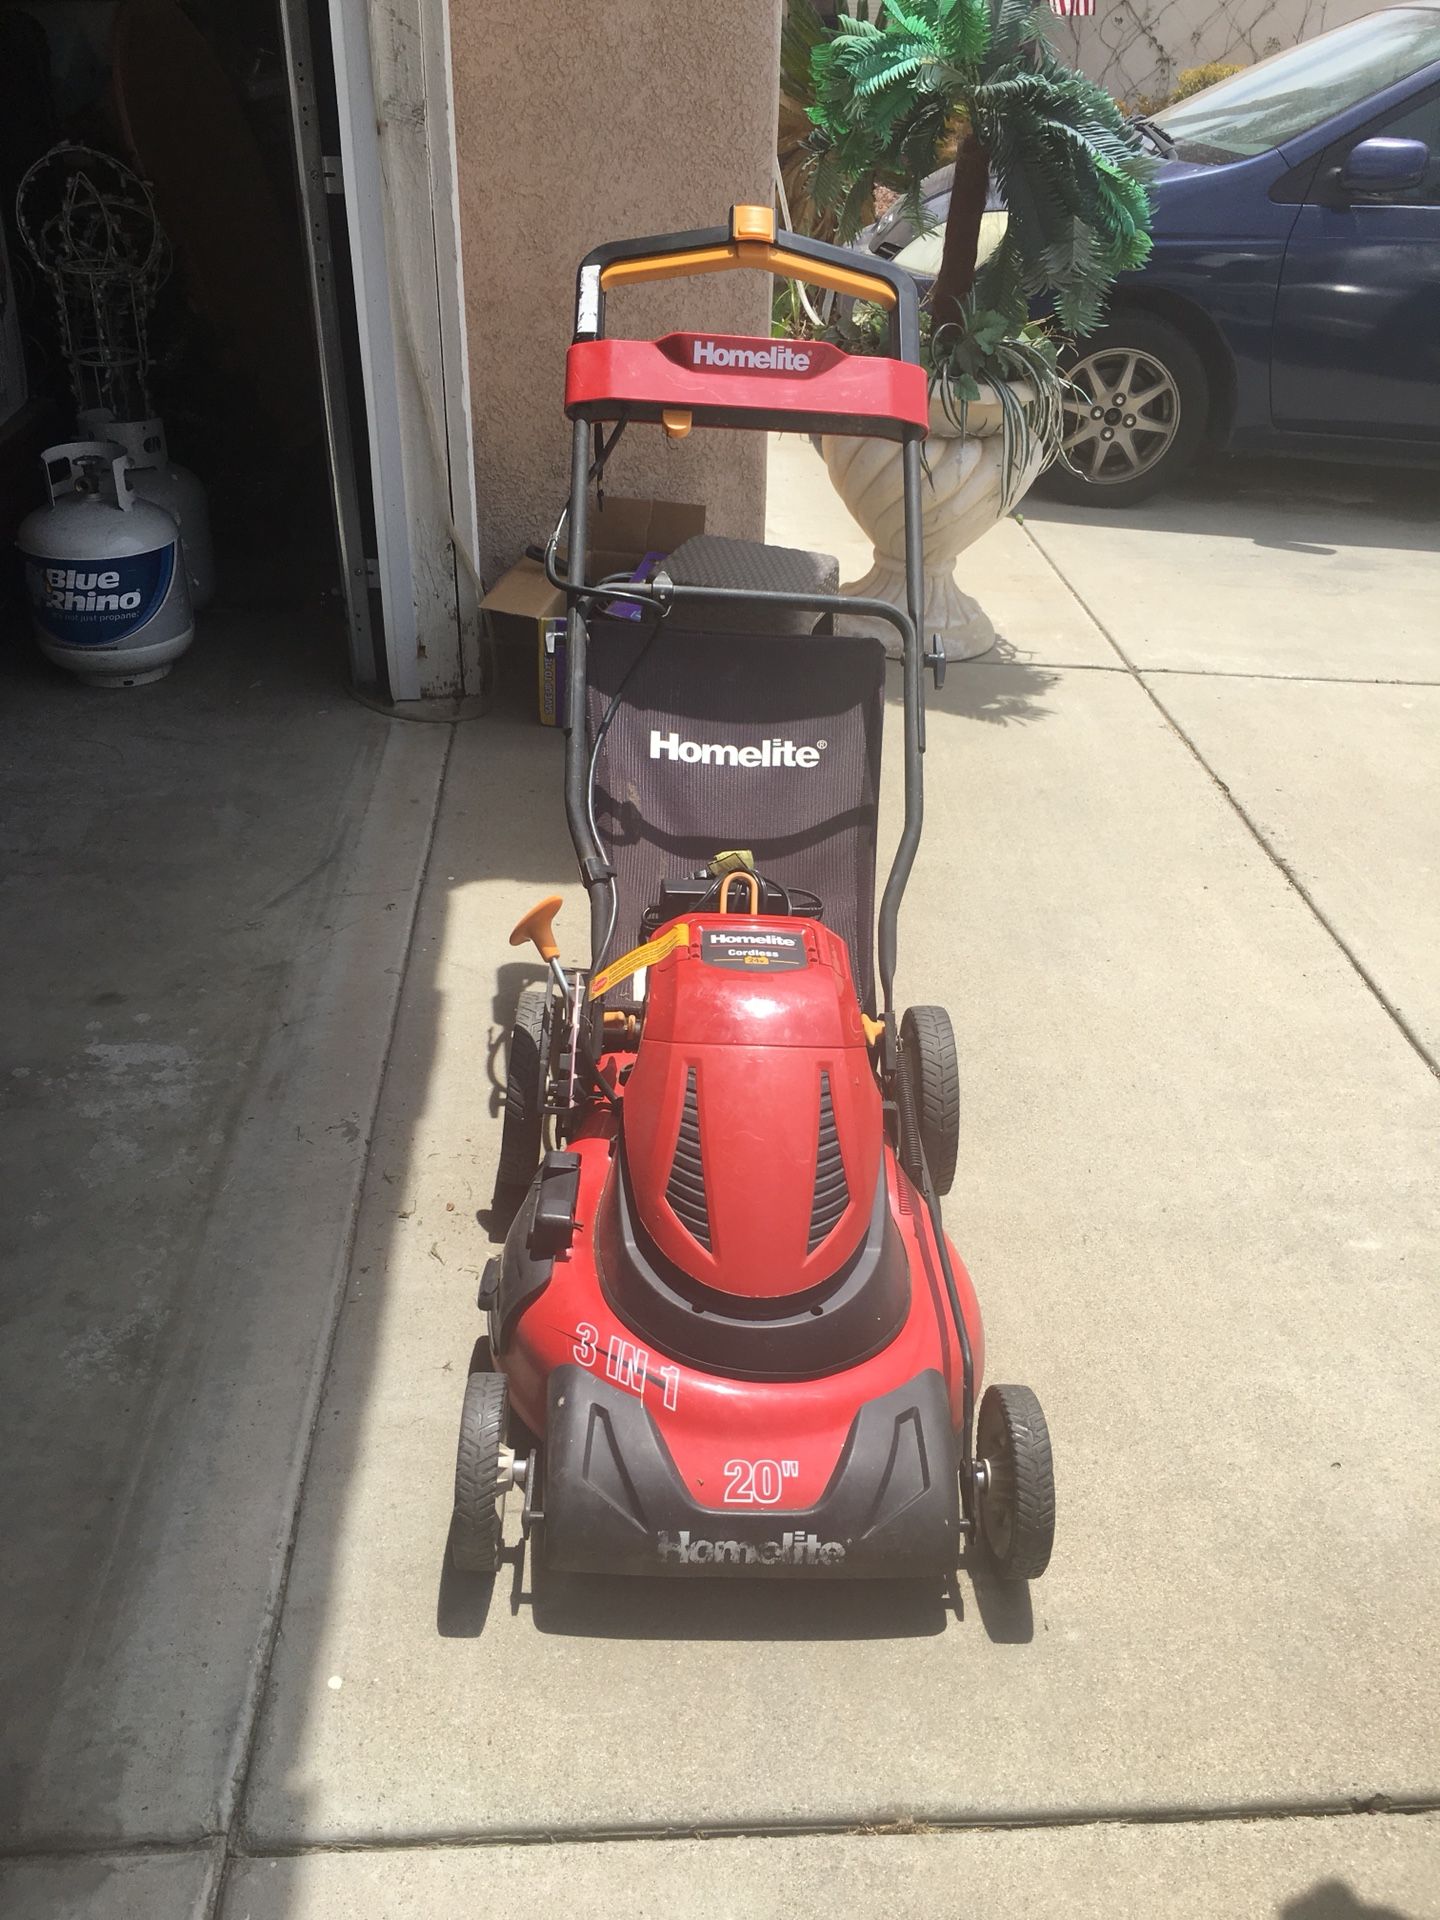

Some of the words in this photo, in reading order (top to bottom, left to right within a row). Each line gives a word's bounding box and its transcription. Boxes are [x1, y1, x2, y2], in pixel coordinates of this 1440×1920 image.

[693, 340, 809, 371] Homelite
[46, 568, 120, 590] Blue
[46, 590, 141, 611] Rhino
[80, 613, 97, 622] just
[710, 934, 796, 946] Homelite
[728, 949, 779, 957] Cordless
[573, 1322, 599, 1366] 3
[606, 1335, 648, 1393] IN
[660, 1365, 680, 1412] 1
[723, 1459, 799, 1504] 20"
[657, 1530, 847, 1566] Homelite
